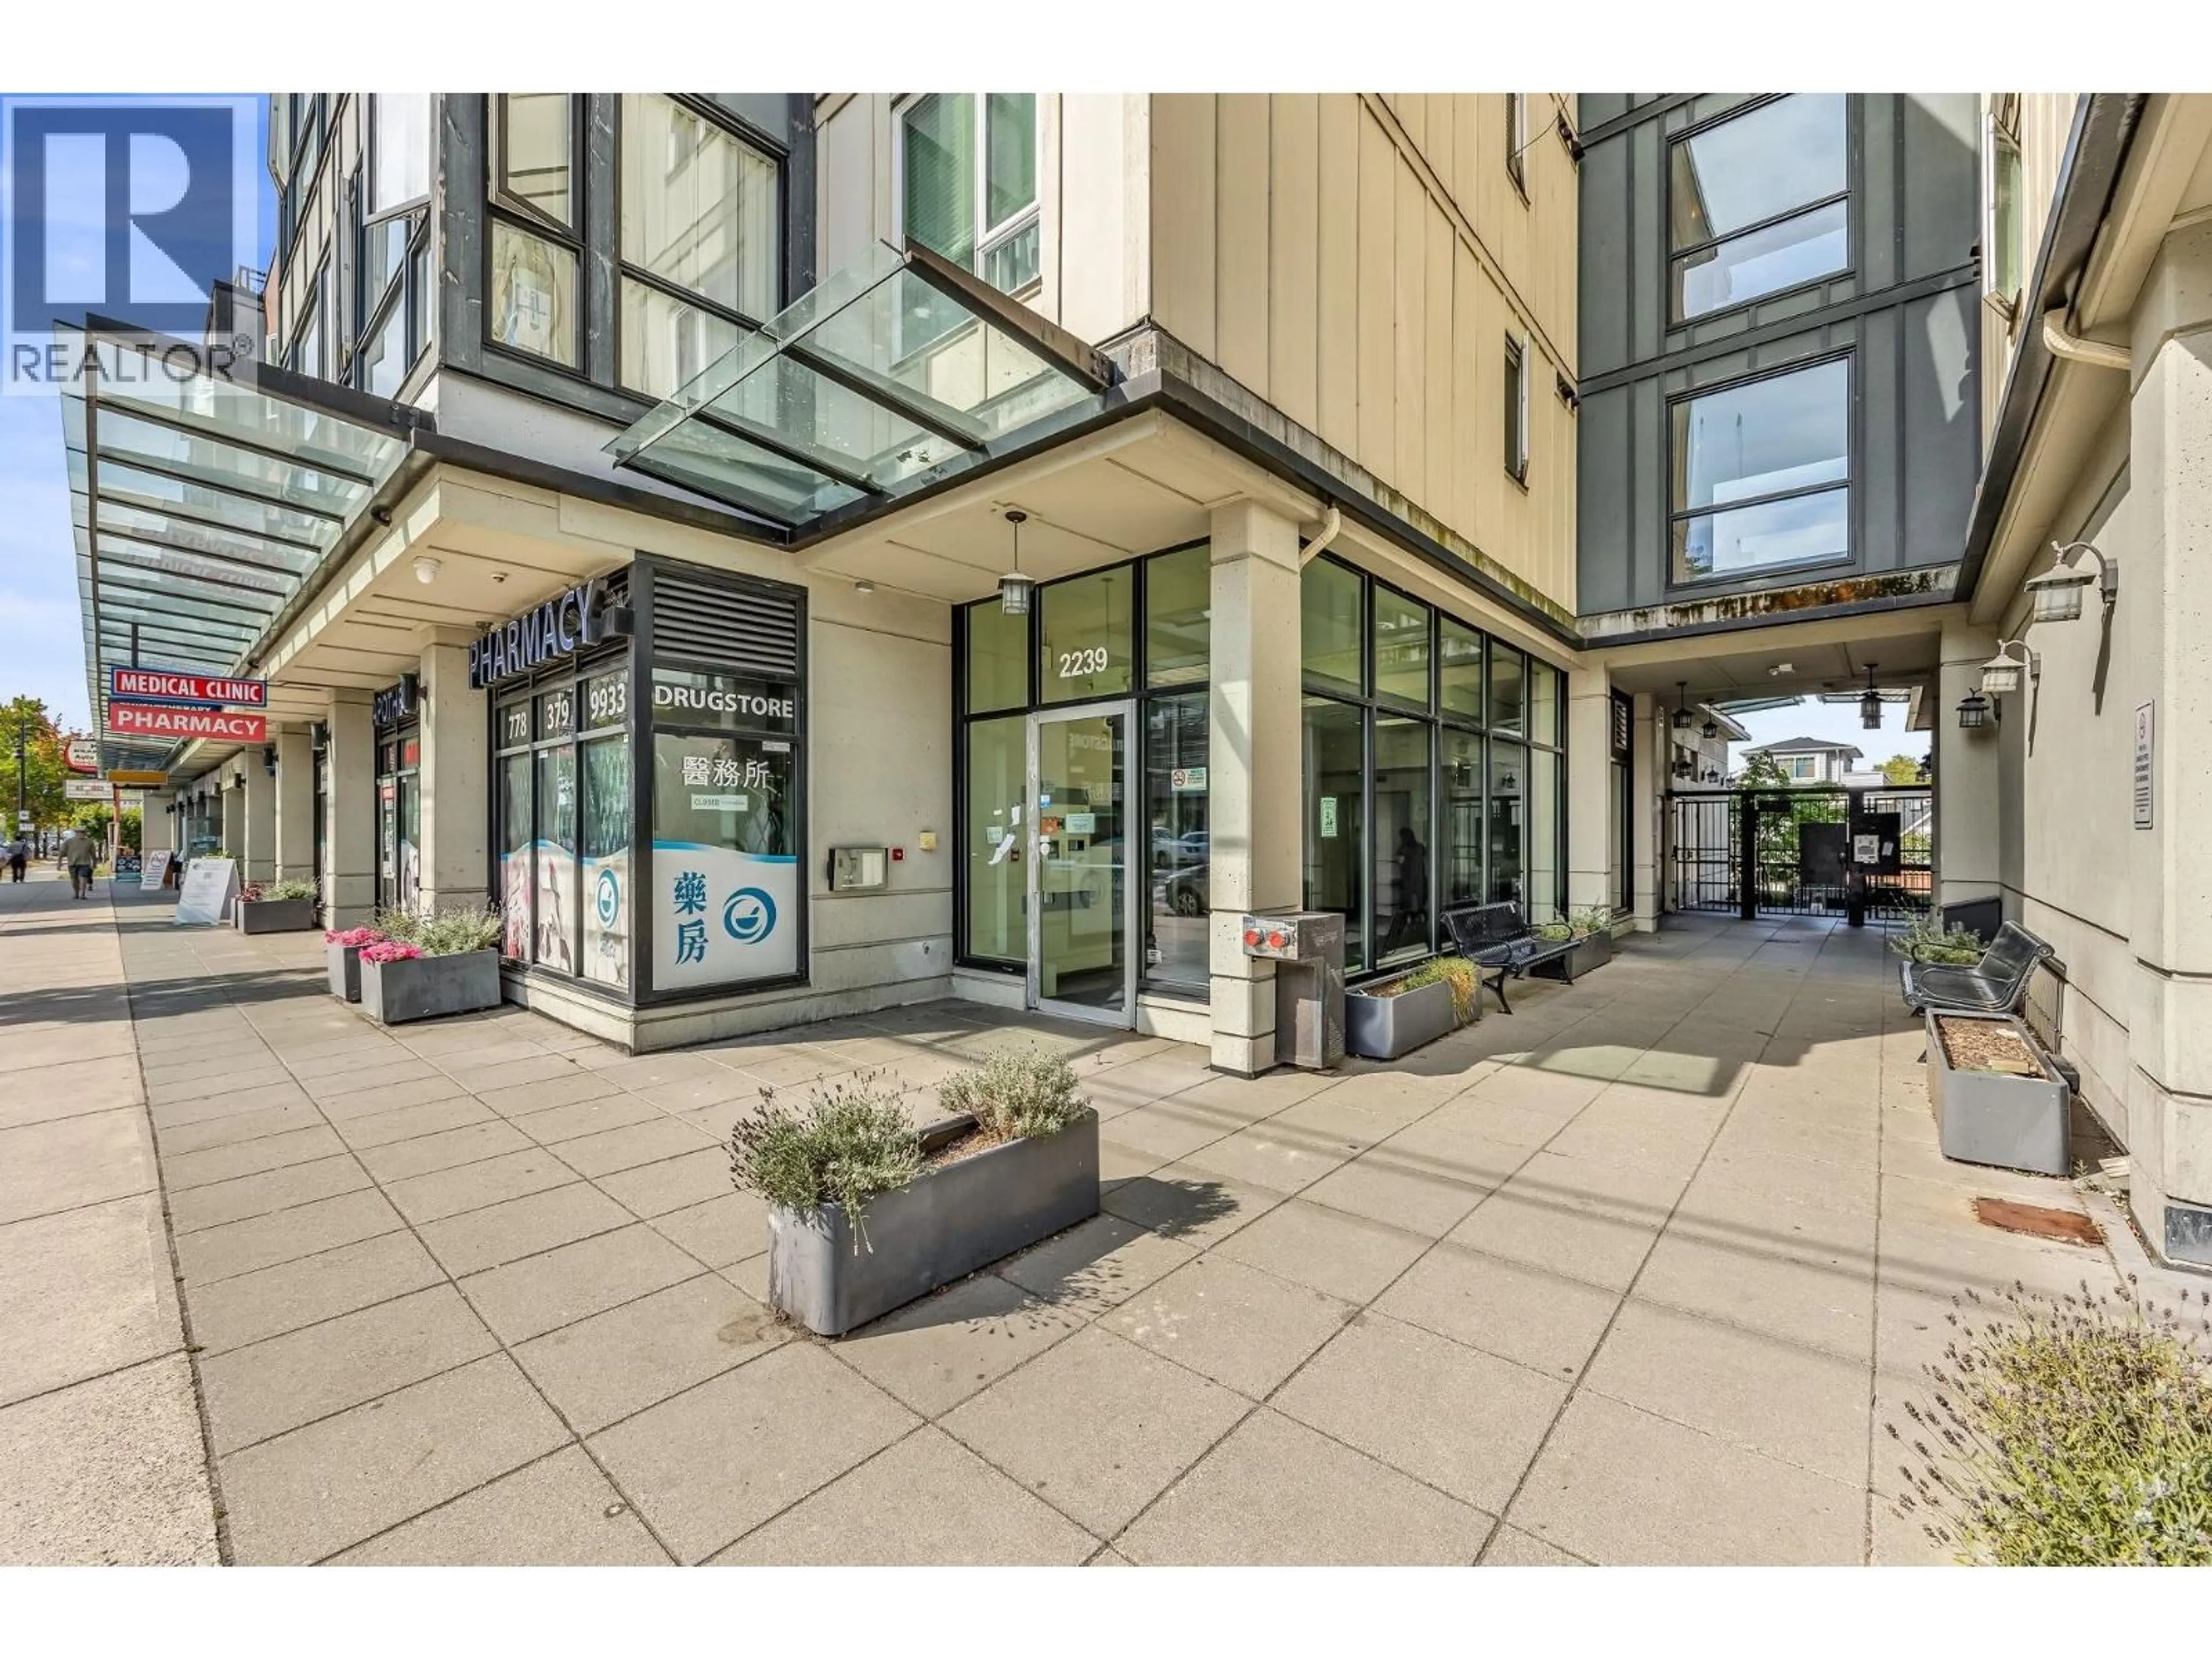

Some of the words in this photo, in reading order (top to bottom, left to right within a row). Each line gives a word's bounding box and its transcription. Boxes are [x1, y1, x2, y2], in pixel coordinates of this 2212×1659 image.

[469, 579, 594, 685] PHARMACY
[1059, 646, 1108, 677] 2239
[120, 673, 199, 696] MEDICAL
[206, 681, 259, 701] CLINIC
[654, 685, 794, 718] DRUGSTORE
[118, 710, 259, 736] PHARMACY
[508, 712, 527, 739] 778
[547, 699, 570, 730] 379
[590, 683, 626, 720] 9933
[681, 756, 770, 789] 醫務所
[673, 871, 709, 965] 藥房
